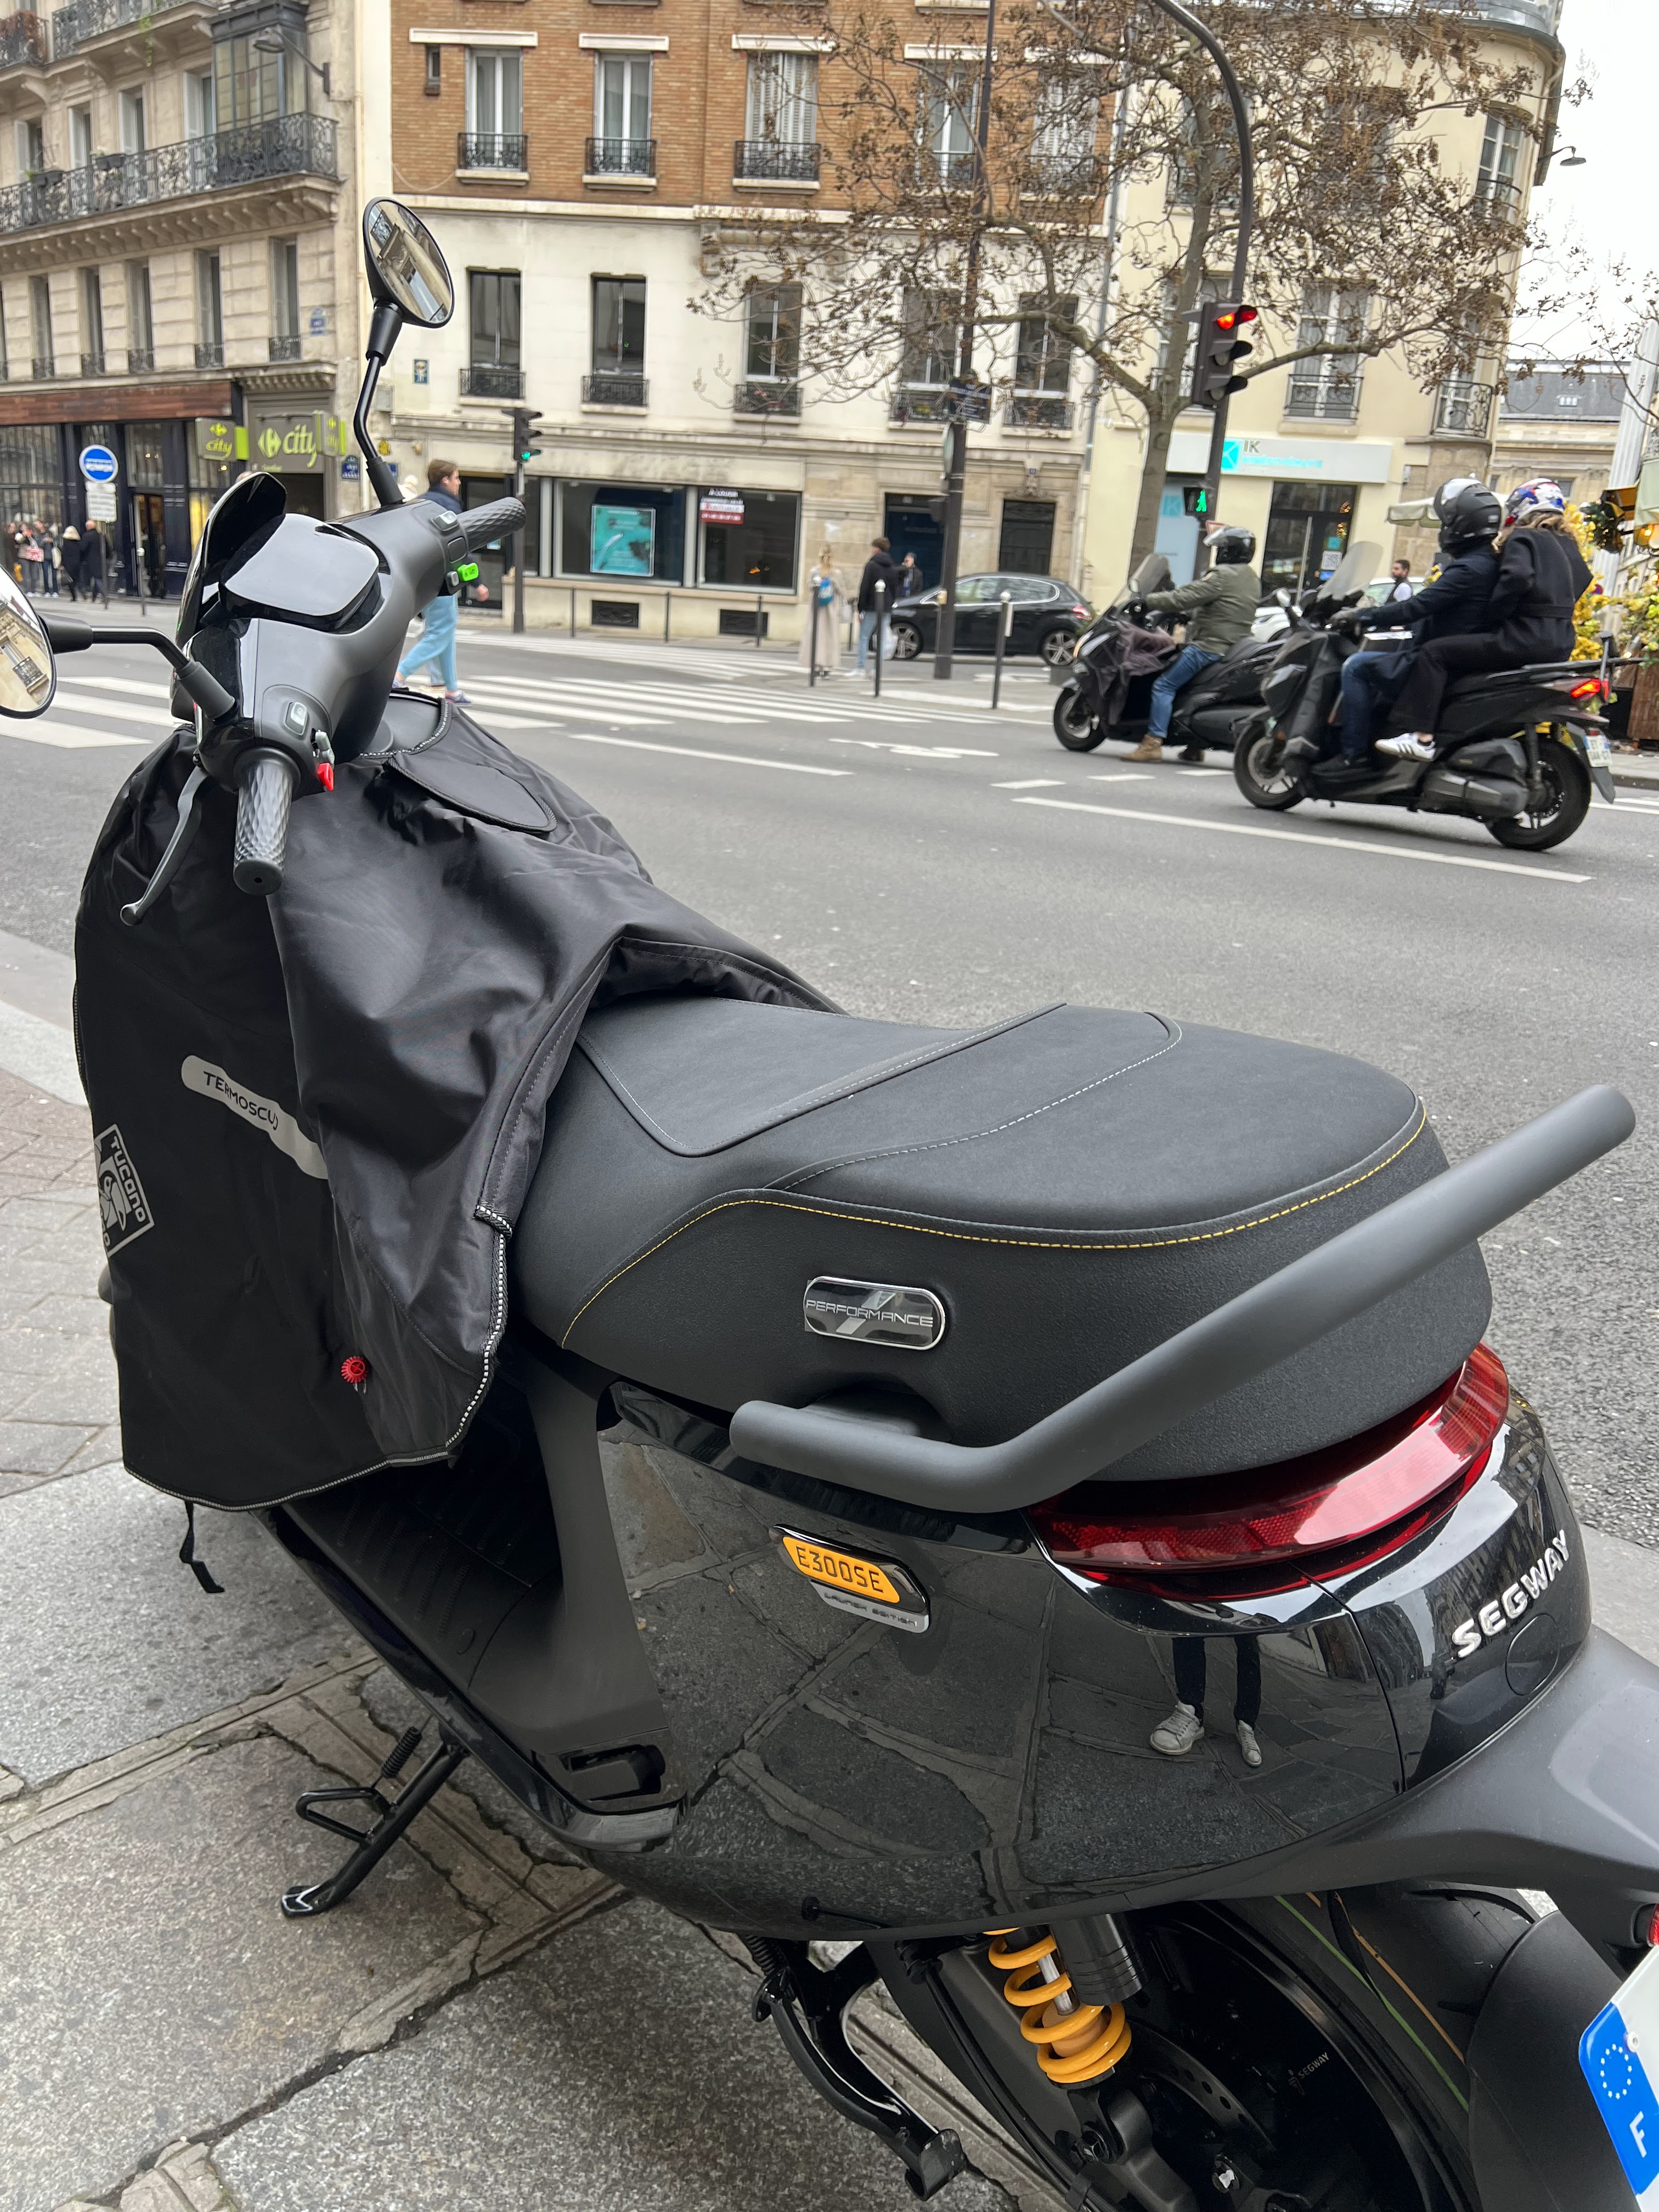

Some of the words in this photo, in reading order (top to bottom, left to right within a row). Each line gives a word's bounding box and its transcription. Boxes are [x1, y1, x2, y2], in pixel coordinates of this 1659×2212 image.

[206, 438, 232, 458] city
[283, 424, 317, 467] city
[1243, 439, 1261, 453] IK
[806, 1299, 933, 1328] PERFORMANCE
[796, 1546, 884, 1593] E300SE
[1452, 1529, 1570, 1658] SEGWAY
[1298, 2052, 1329, 2079] SEGWAY
[1629, 2111, 1647, 2158] F
